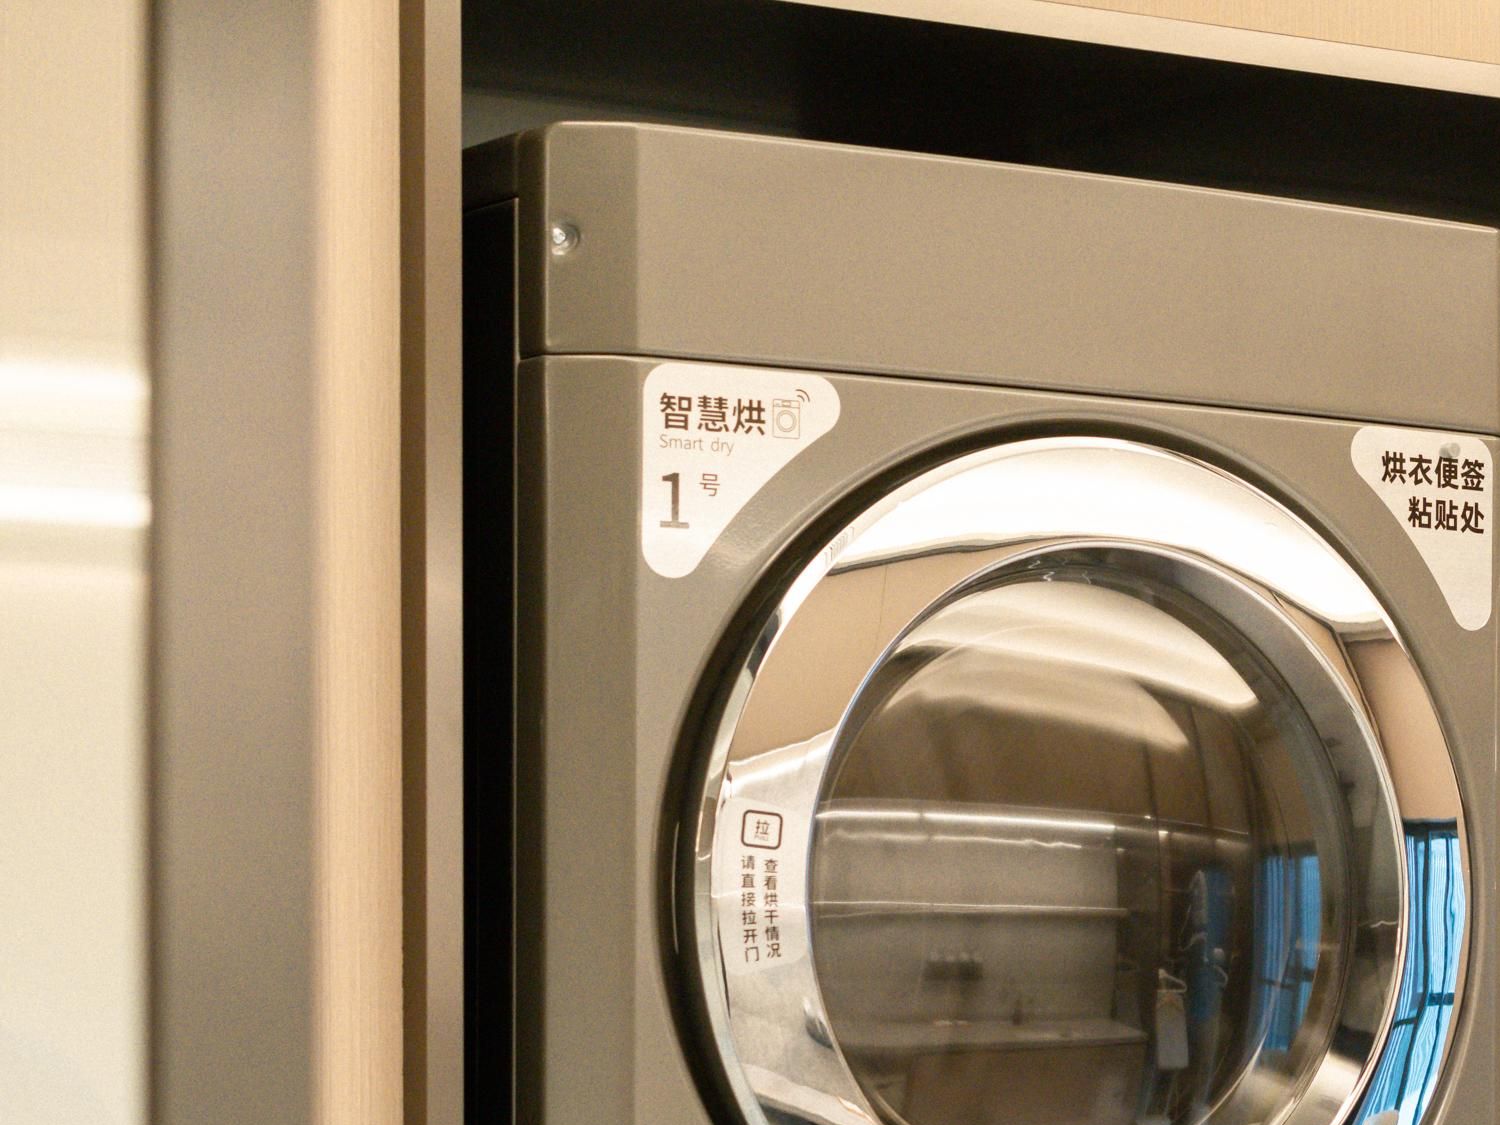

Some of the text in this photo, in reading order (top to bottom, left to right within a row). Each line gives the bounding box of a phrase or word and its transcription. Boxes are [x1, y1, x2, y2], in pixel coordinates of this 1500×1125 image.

[659, 391, 767, 436] 智慧烘
[659, 433, 735, 457] Smart dry
[1381, 450, 1485, 492] 烘衣便签
[660, 472, 721, 529] 1 号
[1407, 496, 1485, 534] 粘贴处
[755, 819, 770, 835] 拉
[740, 855, 760, 963] 请直接拉开门
[764, 859, 782, 959] 查看烘干情况
